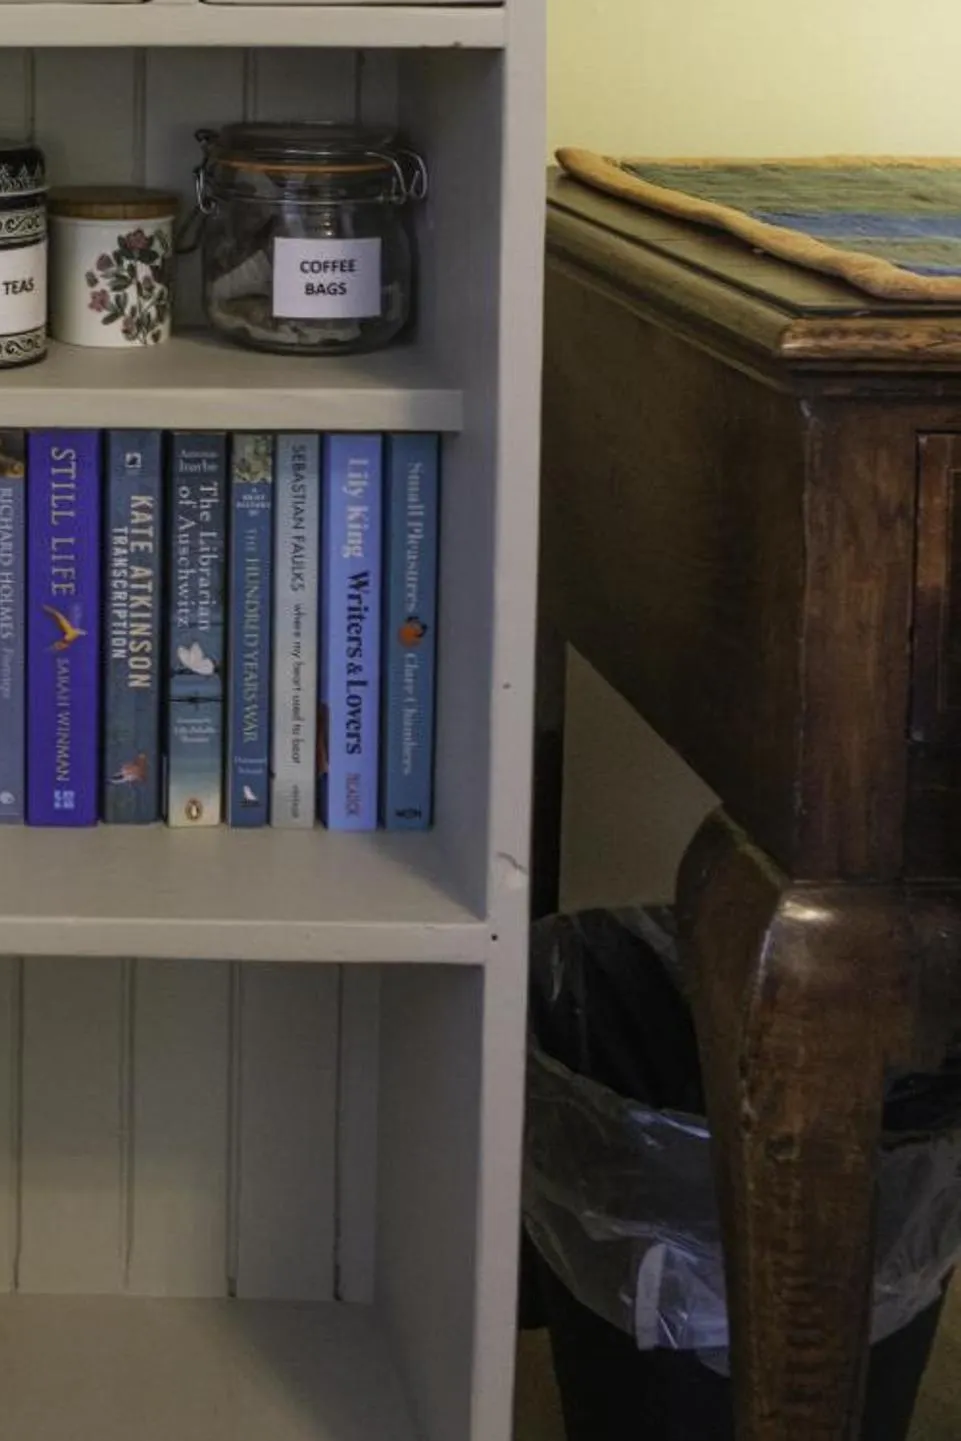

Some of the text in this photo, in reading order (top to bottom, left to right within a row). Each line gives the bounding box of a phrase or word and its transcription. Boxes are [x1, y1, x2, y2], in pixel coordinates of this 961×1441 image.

[3, 277, 34, 296] TEAS
[300, 259, 356, 274] COFFEE
[304, 283, 347, 296] BAGS
[50, 447, 77, 597] STILL LIFE
[176, 485, 196, 628] of Auschwitz
[197, 481, 219, 632] The Librarian
[290, 444, 307, 592] SEBASTIAN FAULKS
[342, 458, 369, 559] Lily King
[404, 461, 425, 612] Small Pleasures
[110, 526, 128, 660] TRANSCRIPTION
[127, 495, 153, 688] KATE ATKINSON
[242, 557, 259, 648] HUNDRED
[54, 657, 71, 782] SARAH WINMAN
[242, 704, 258, 743] WAR
[344, 571, 370, 756] Writers & Lovers
